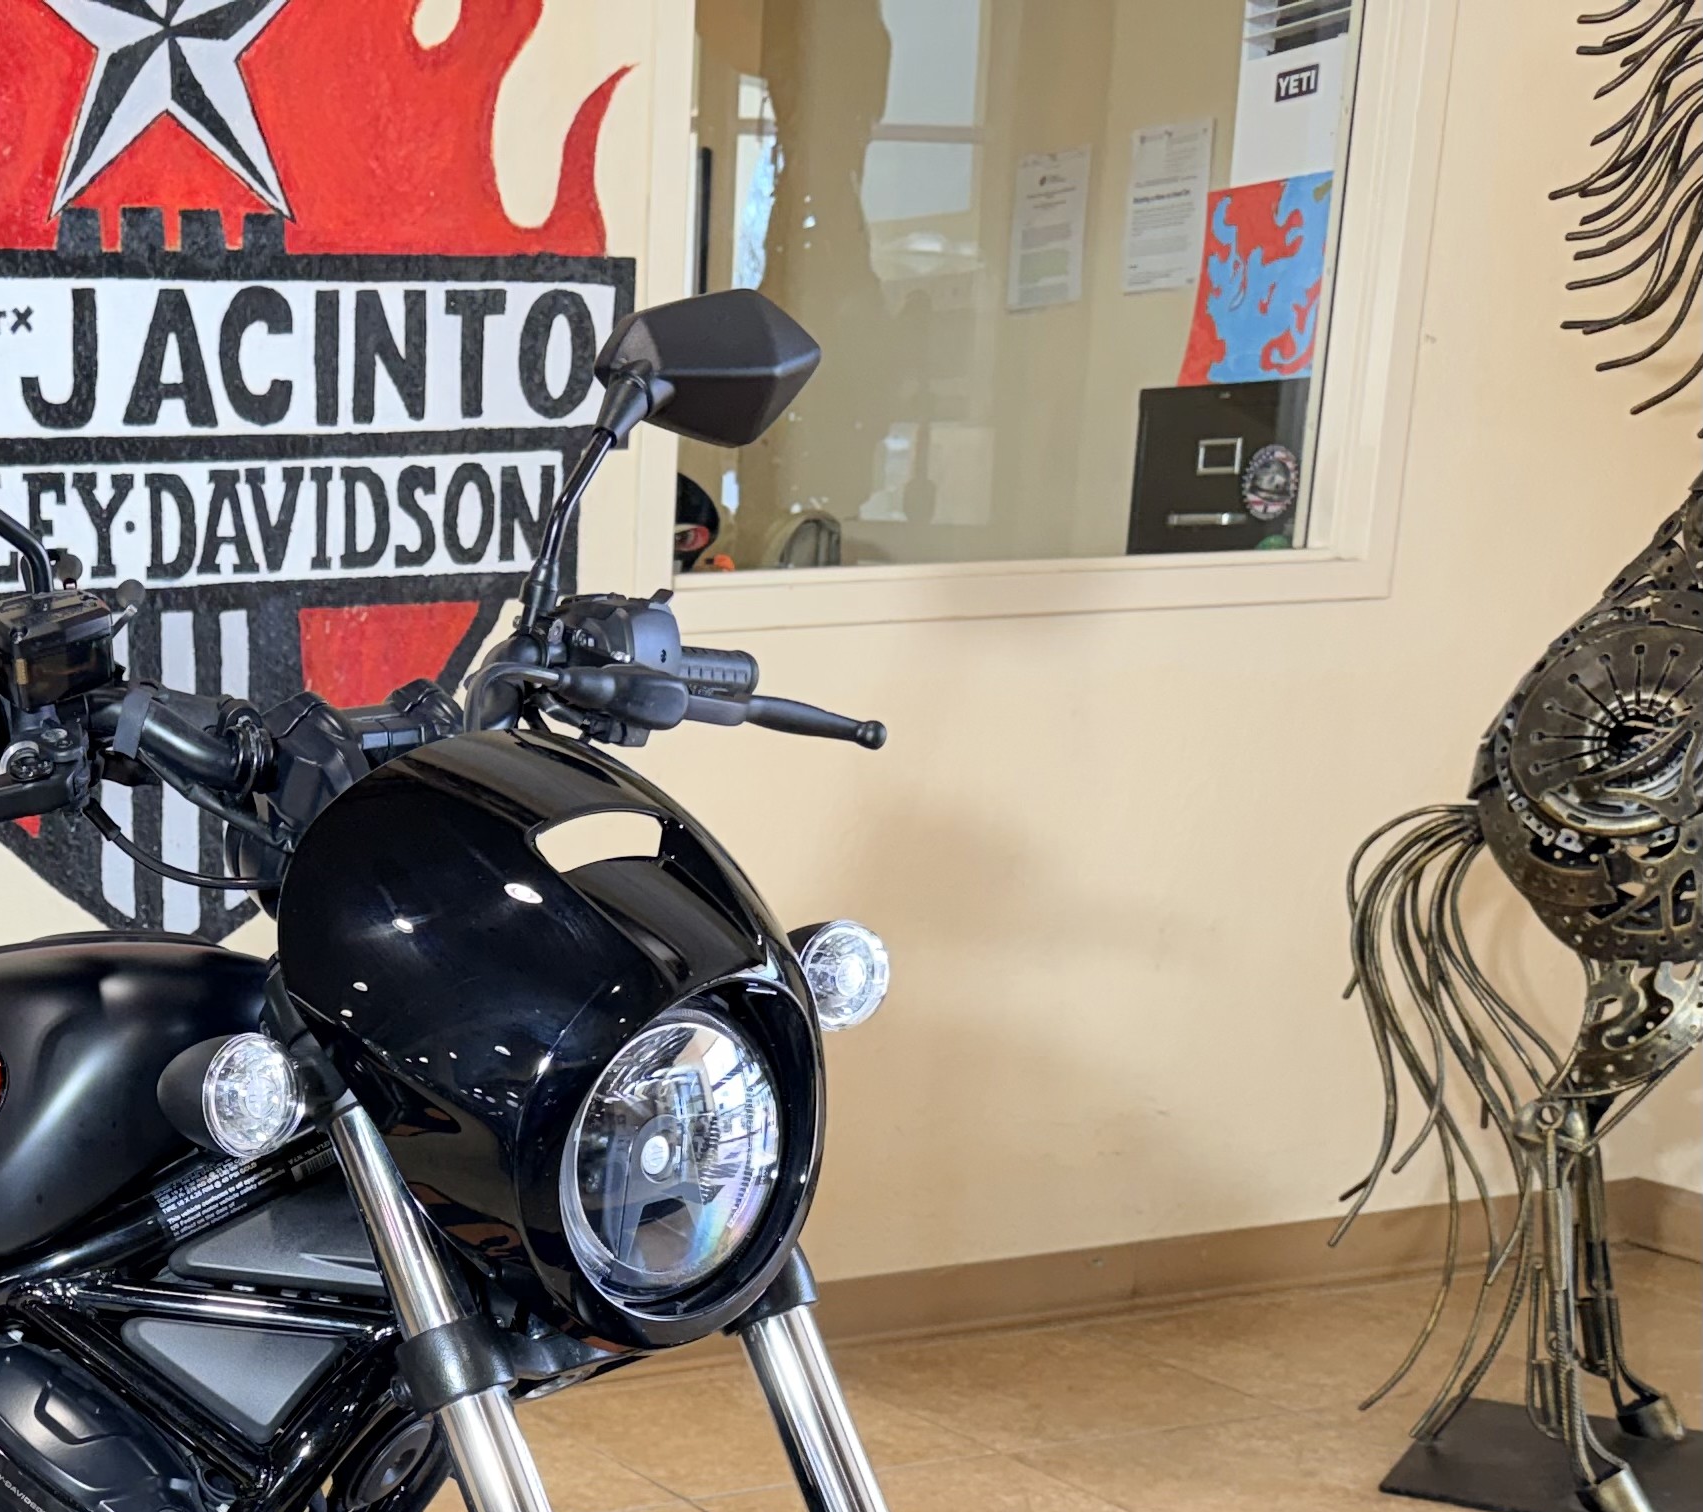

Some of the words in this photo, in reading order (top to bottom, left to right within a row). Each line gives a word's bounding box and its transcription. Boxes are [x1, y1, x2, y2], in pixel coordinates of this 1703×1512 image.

[1279, 70, 1316, 97] YETI
[21, 286, 597, 428] JACINTO
[166, 1213, 181, 1225] This
[180, 1203, 202, 1218] vehicle
[200, 1189, 229, 1207] conforms
[169, 1222, 180, 1231] US
[178, 1211, 202, 1226] Federal
[200, 1201, 220, 1215] motor
[218, 1191, 240, 1206] vehicle
[238, 1182, 257, 1195] safety
